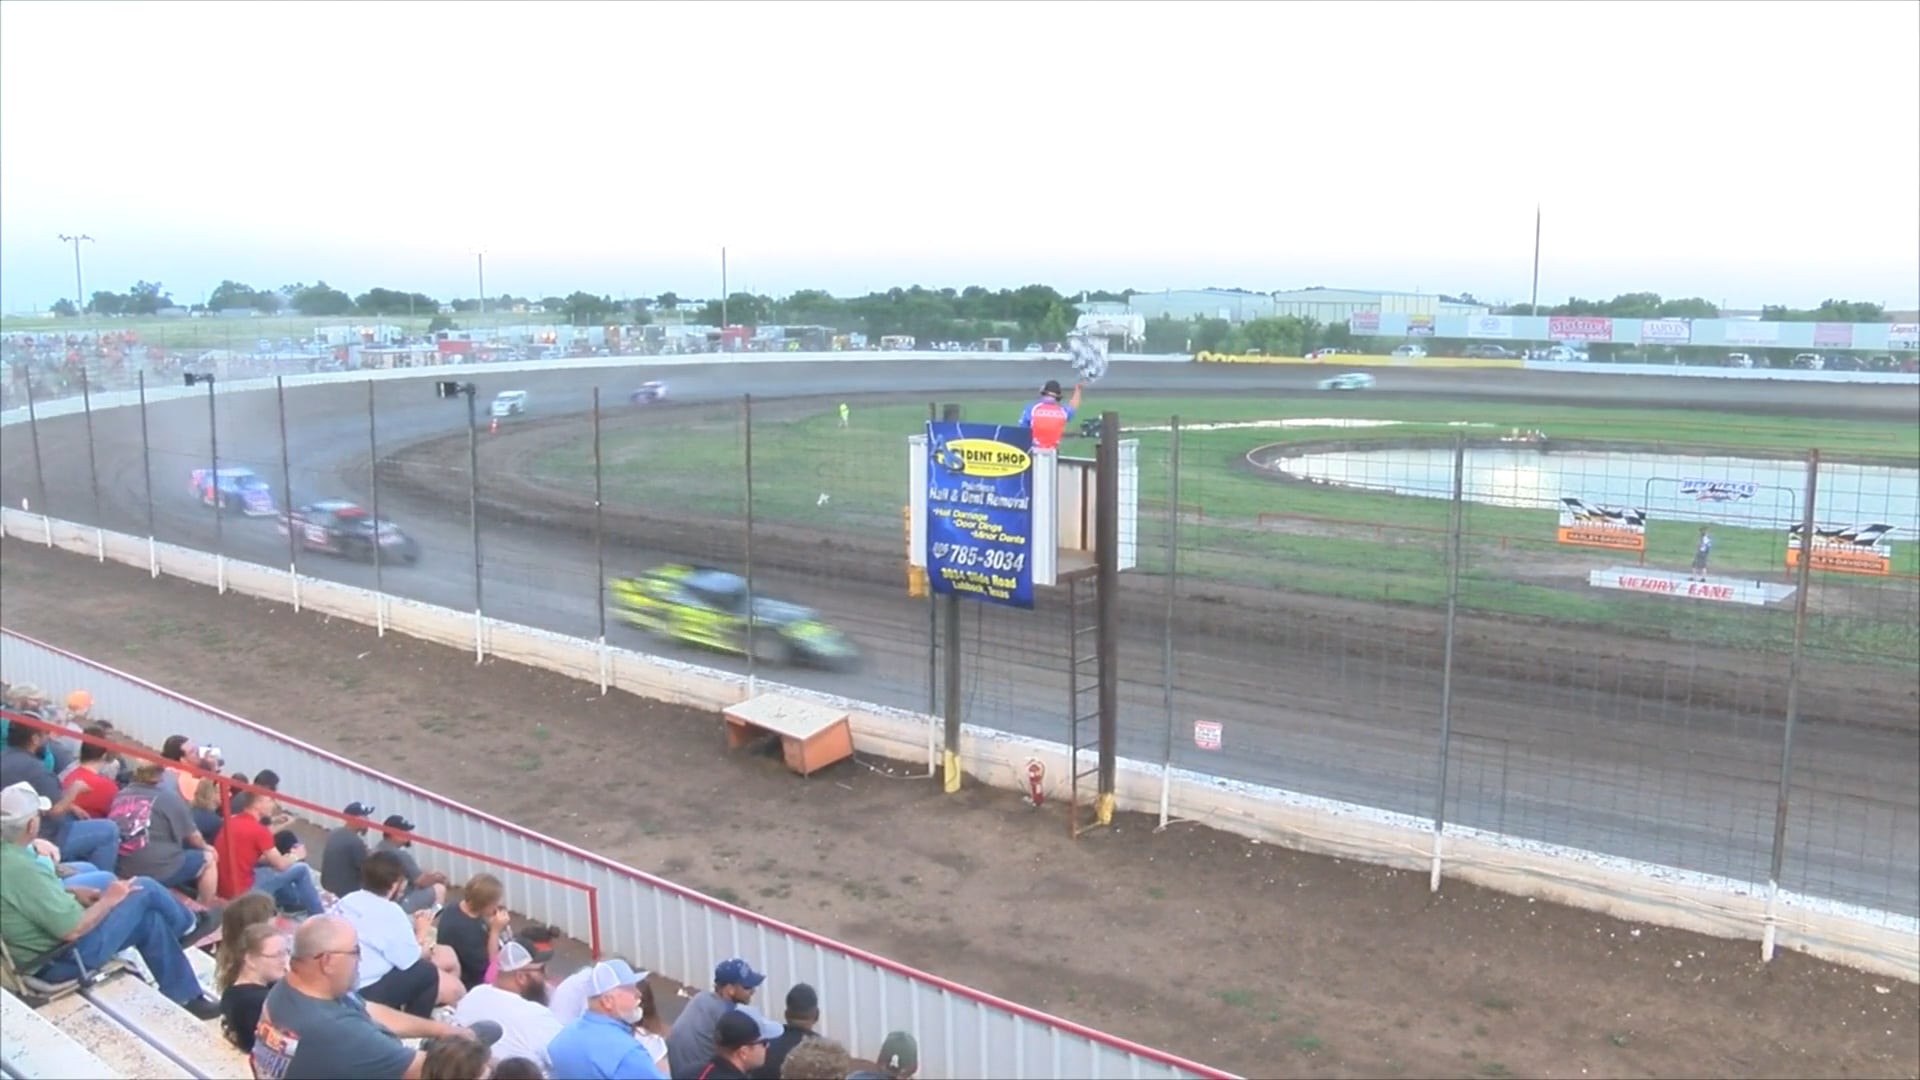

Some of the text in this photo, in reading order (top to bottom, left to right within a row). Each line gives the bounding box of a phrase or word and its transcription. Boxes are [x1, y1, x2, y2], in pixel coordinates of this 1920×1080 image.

[966, 450, 1027, 465] DENT SHOP
[929, 487, 1030, 510] Hail & Dent Removal
[949, 544, 1025, 572] 785-3034
[991, 574, 1017, 589] Road
[1617, 575, 1735, 599] VICTORY LANE
